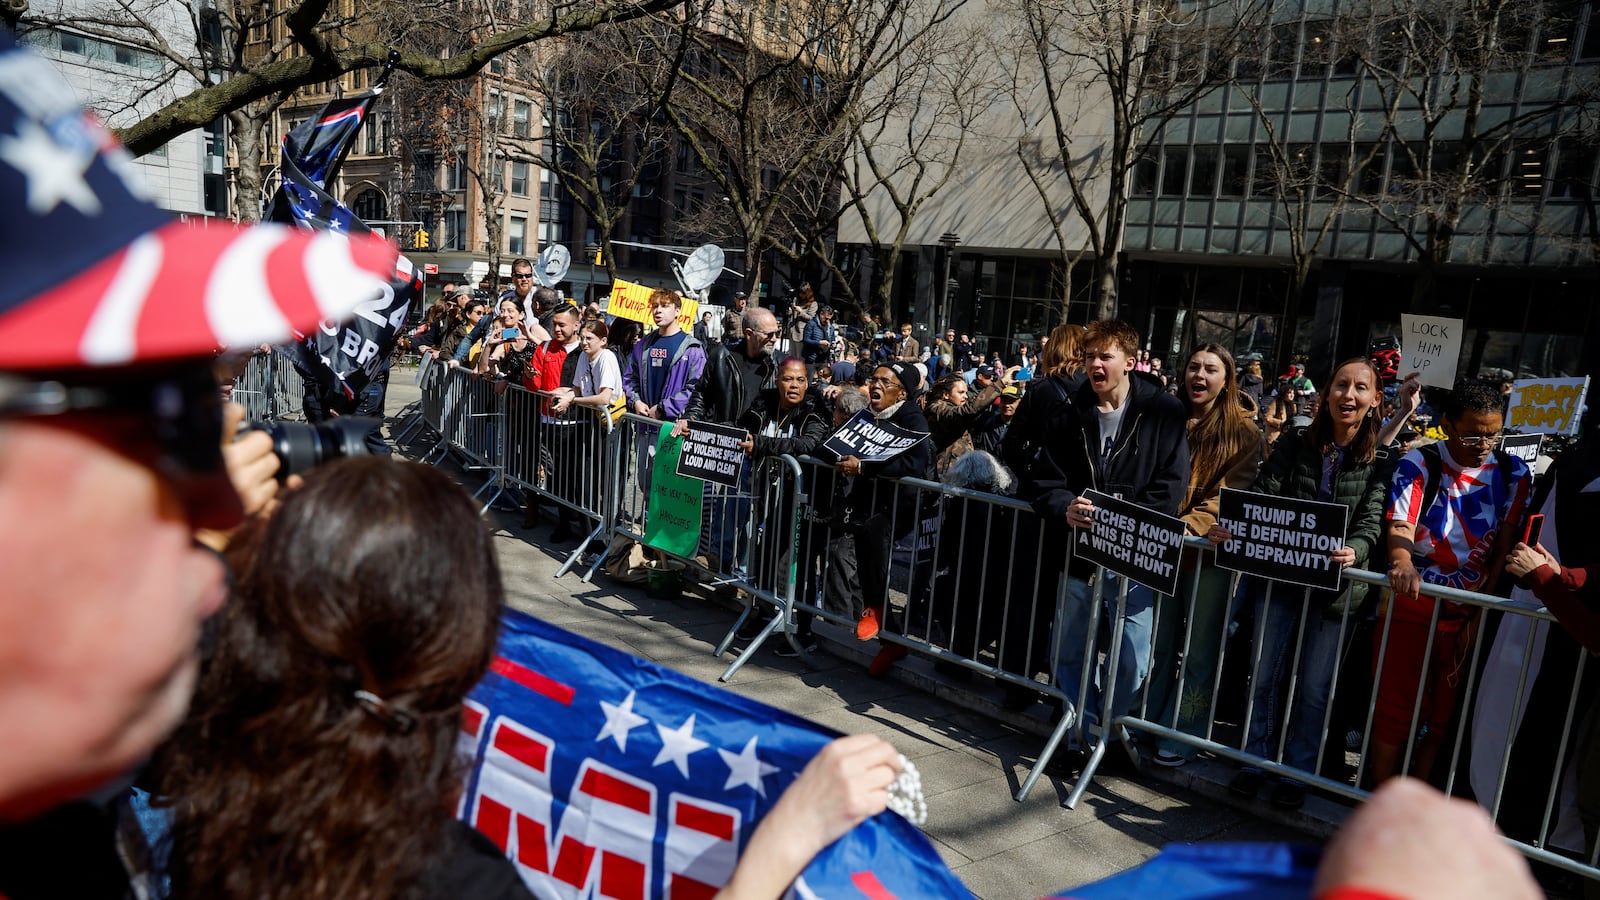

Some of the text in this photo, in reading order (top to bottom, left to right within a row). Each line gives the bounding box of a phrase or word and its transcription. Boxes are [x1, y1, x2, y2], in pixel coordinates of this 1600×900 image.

[614, 287, 646, 313] Trump
[1411, 321, 1448, 340] LOCK
[650, 348, 667, 358] USA
[1417, 340, 1442, 357] HIM
[1413, 357, 1431, 371] UP
[1515, 384, 1584, 408] TRUMPY
[689, 429, 716, 444] TRUMP'S
[835, 428, 860, 448] ALL
[858, 440, 885, 456] THE
[853, 418, 895, 445] TRUMP
[683, 441, 742, 463] OF VIOLENCE SPEAK
[684, 454, 736, 476] LOUD AND CLEAR
[1243, 503, 1317, 529] TRUMP IS
[1091, 522, 1167, 559] THIS IS NOT
[1139, 521, 1183, 548] KNOW
[1220, 517, 1342, 552] THE DEFINITION
[1079, 532, 1173, 578] A WITCH HUNT
[1223, 540, 1332, 571] OF DEPRAVITY
